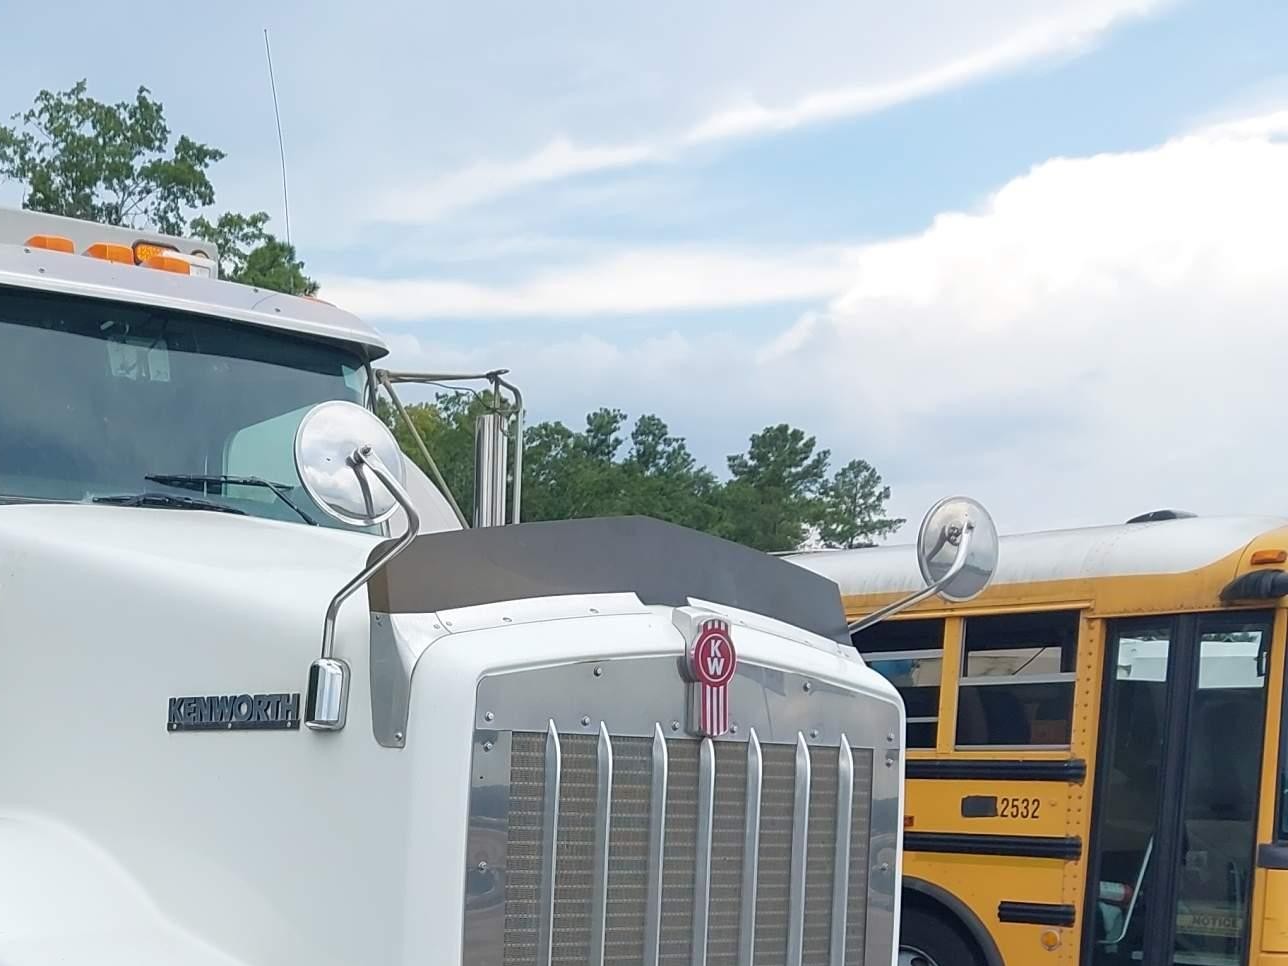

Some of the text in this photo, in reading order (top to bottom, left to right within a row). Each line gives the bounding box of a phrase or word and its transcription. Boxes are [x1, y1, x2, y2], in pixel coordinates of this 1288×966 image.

[168, 694, 300, 722] KENWORTH
[999, 797, 1041, 819] 2532
[1191, 913, 1238, 928] NOTICE
